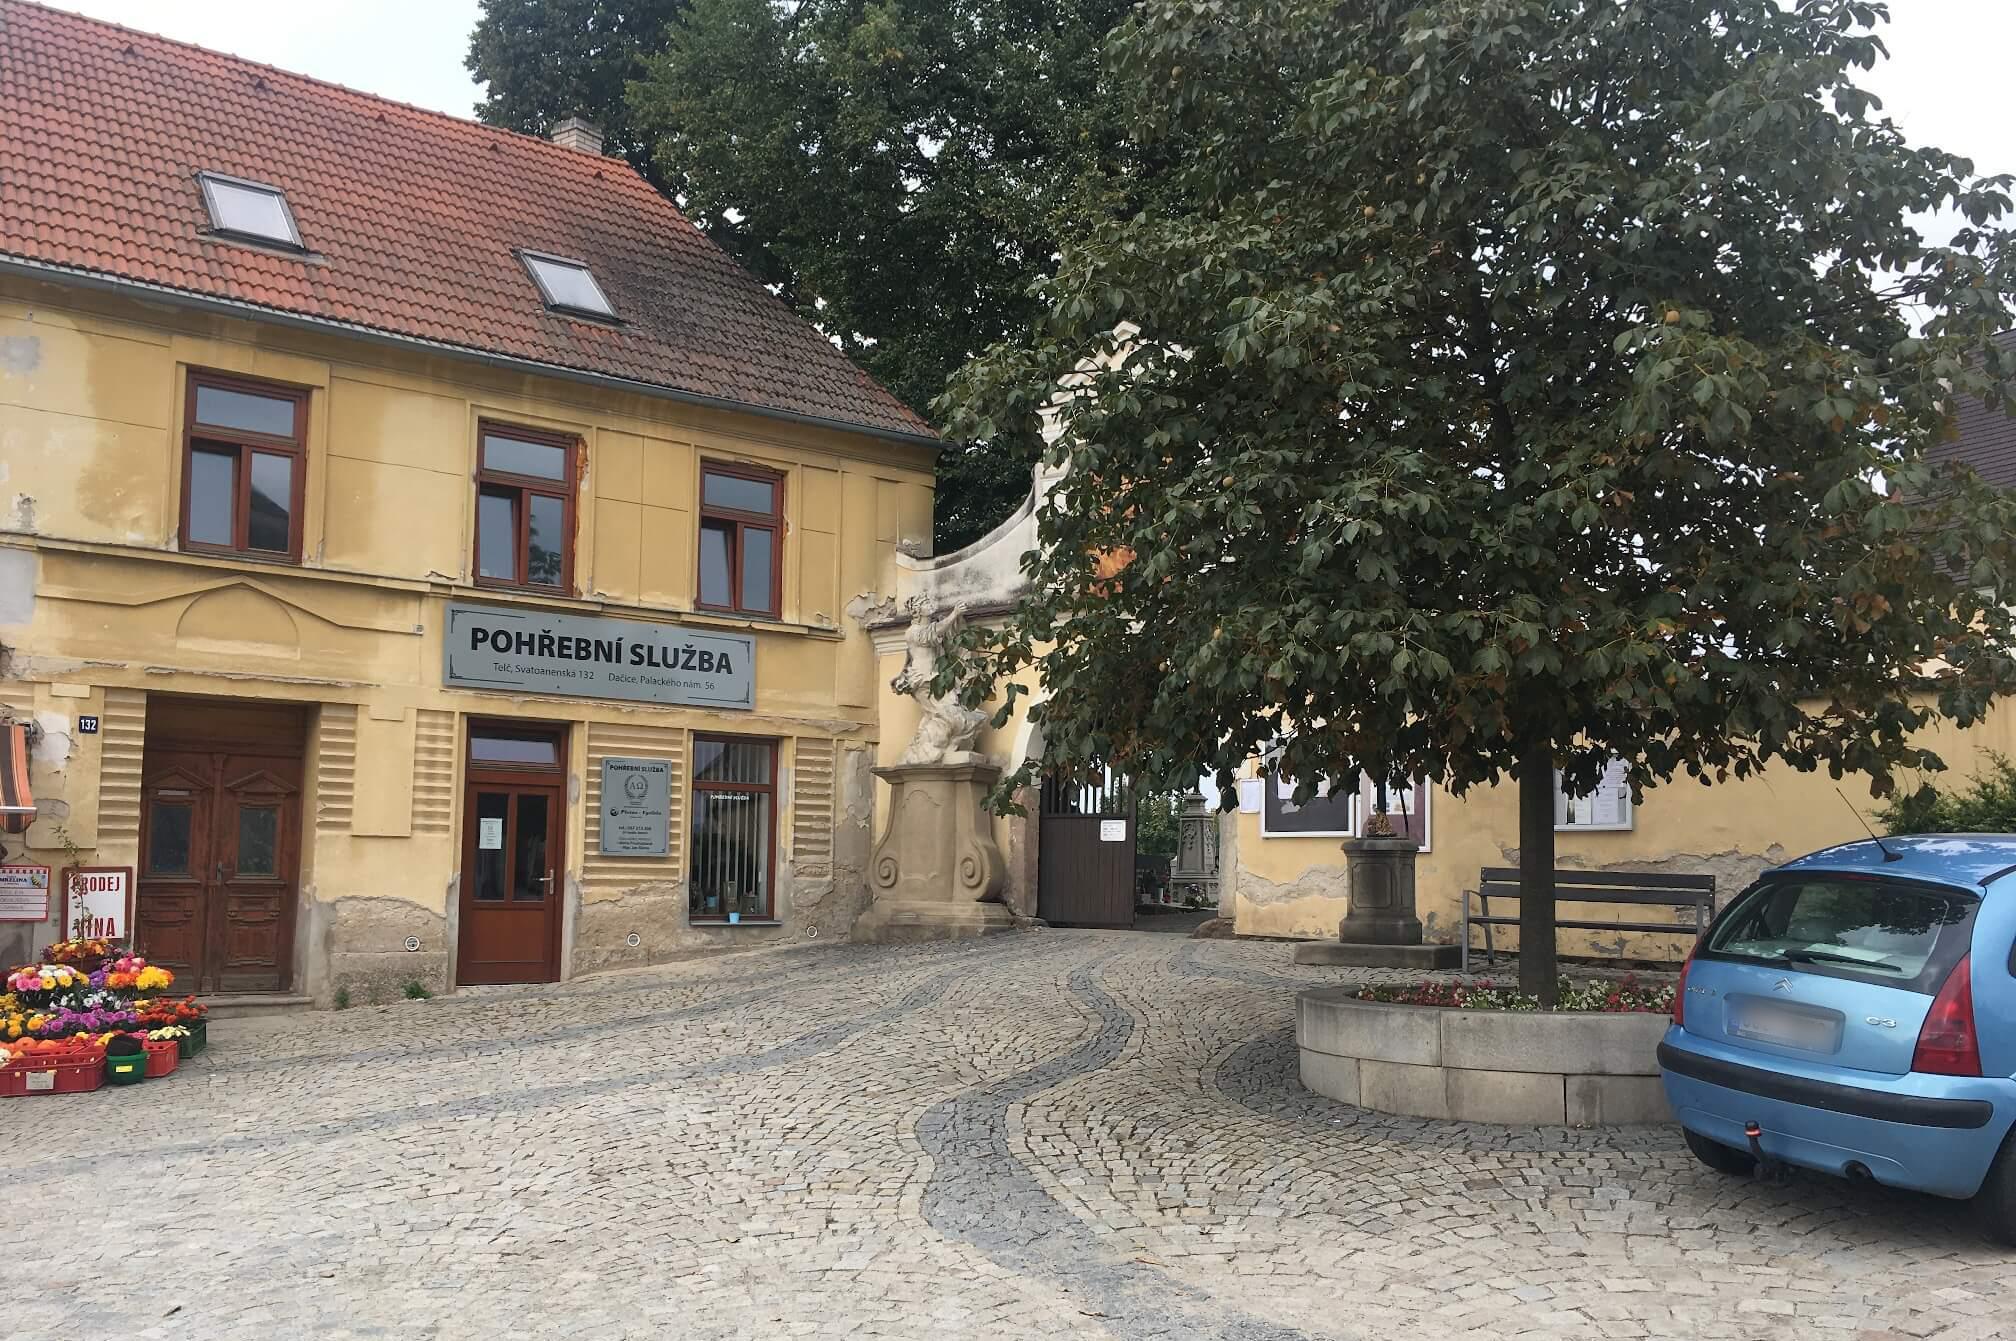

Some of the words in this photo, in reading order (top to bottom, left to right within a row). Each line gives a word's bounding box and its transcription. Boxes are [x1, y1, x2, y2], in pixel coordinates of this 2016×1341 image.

[471, 627, 624, 664] POHŘEBNÍ
[630, 643, 733, 675] SLUŽBA
[579, 670, 595, 680] 132
[640, 675, 682, 688] Palackého
[704, 681, 715, 690] 56
[80, 719, 97, 731] 132
[1866, 1016, 1897, 1028] C3
